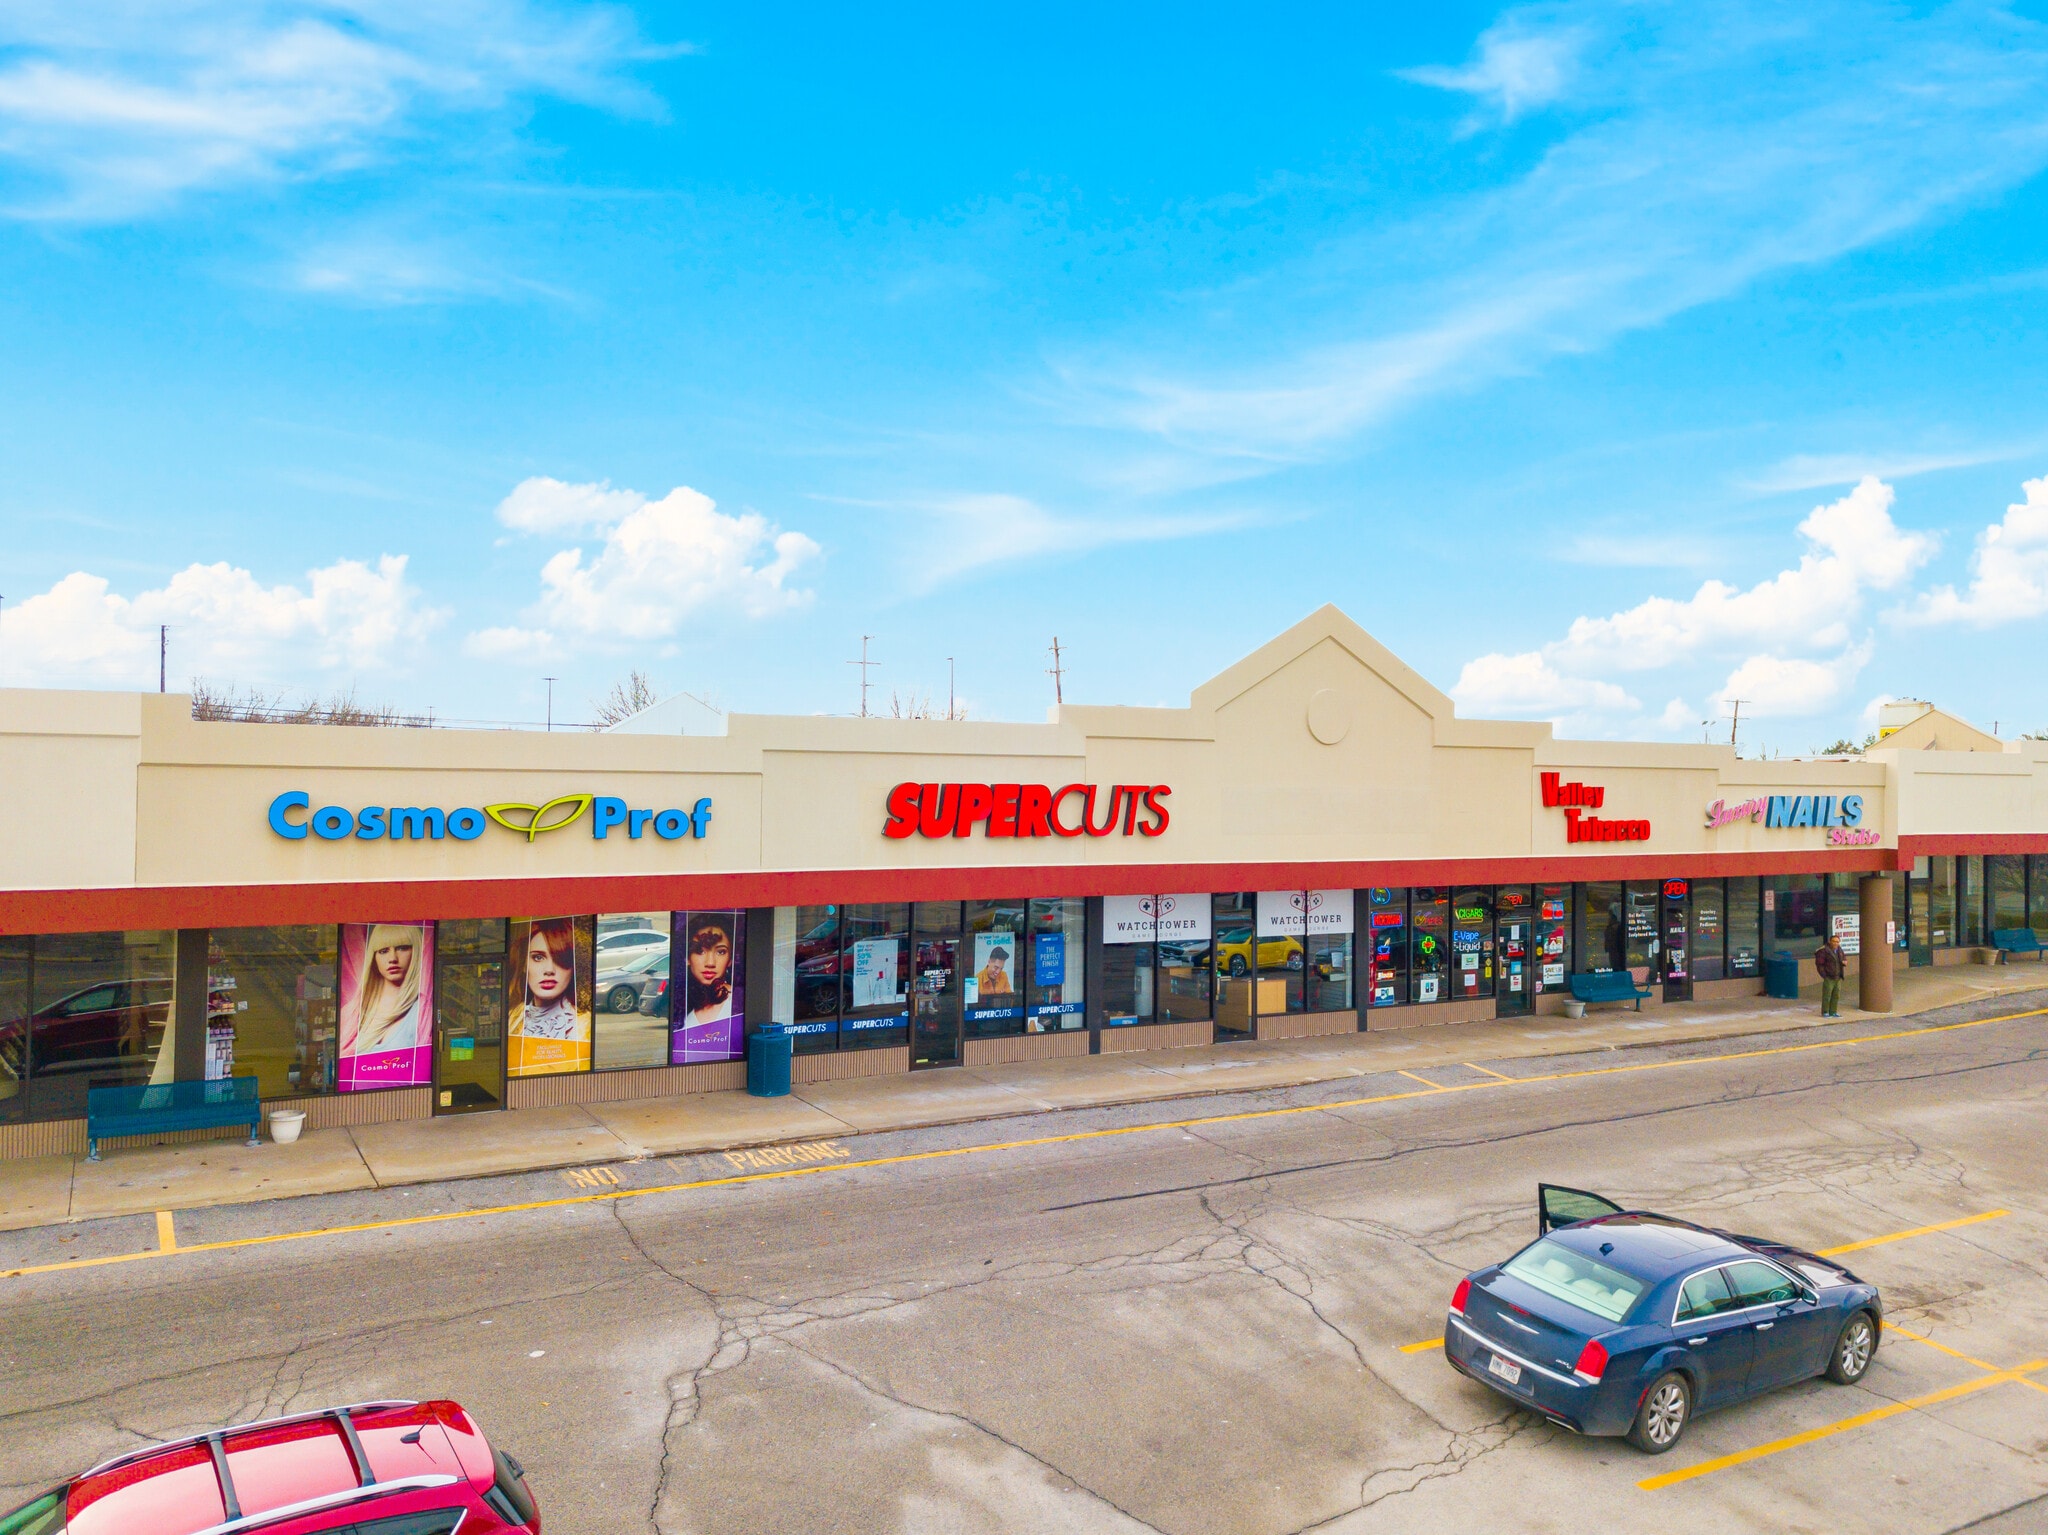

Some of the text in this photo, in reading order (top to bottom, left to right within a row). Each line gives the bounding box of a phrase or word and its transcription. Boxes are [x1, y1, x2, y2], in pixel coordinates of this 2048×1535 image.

[1540, 772, 1604, 808] Valley
[268, 791, 712, 840] Cosmo Prof
[882, 782, 1172, 839] SUPERCUTS
[1705, 795, 1864, 829] Luxury NAILS
[1564, 808, 1651, 843] Tobacco
[1826, 828, 1881, 846] Studio
[1664, 881, 1688, 896] OPEN
[1458, 908, 1483, 918] CIGARS
[1669, 926, 1686, 934] NAILS
[1453, 930, 1480, 942] E-Vape
[1045, 946, 1055, 954] THE
[1040, 953, 1061, 961] PERFECT
[1042, 960, 1059, 968] FINISH
[974, 1008, 1012, 1019] SUPERCUTS
[1038, 1004, 1074, 1014] SUPERCUTS
[783, 1023, 827, 1034] SUPERCUTS
[852, 1018, 894, 1029] SUPERCUTS
[361, 1061, 409, 1072] Cosmo Prof
[564, 1142, 850, 1188] NO PARKING
